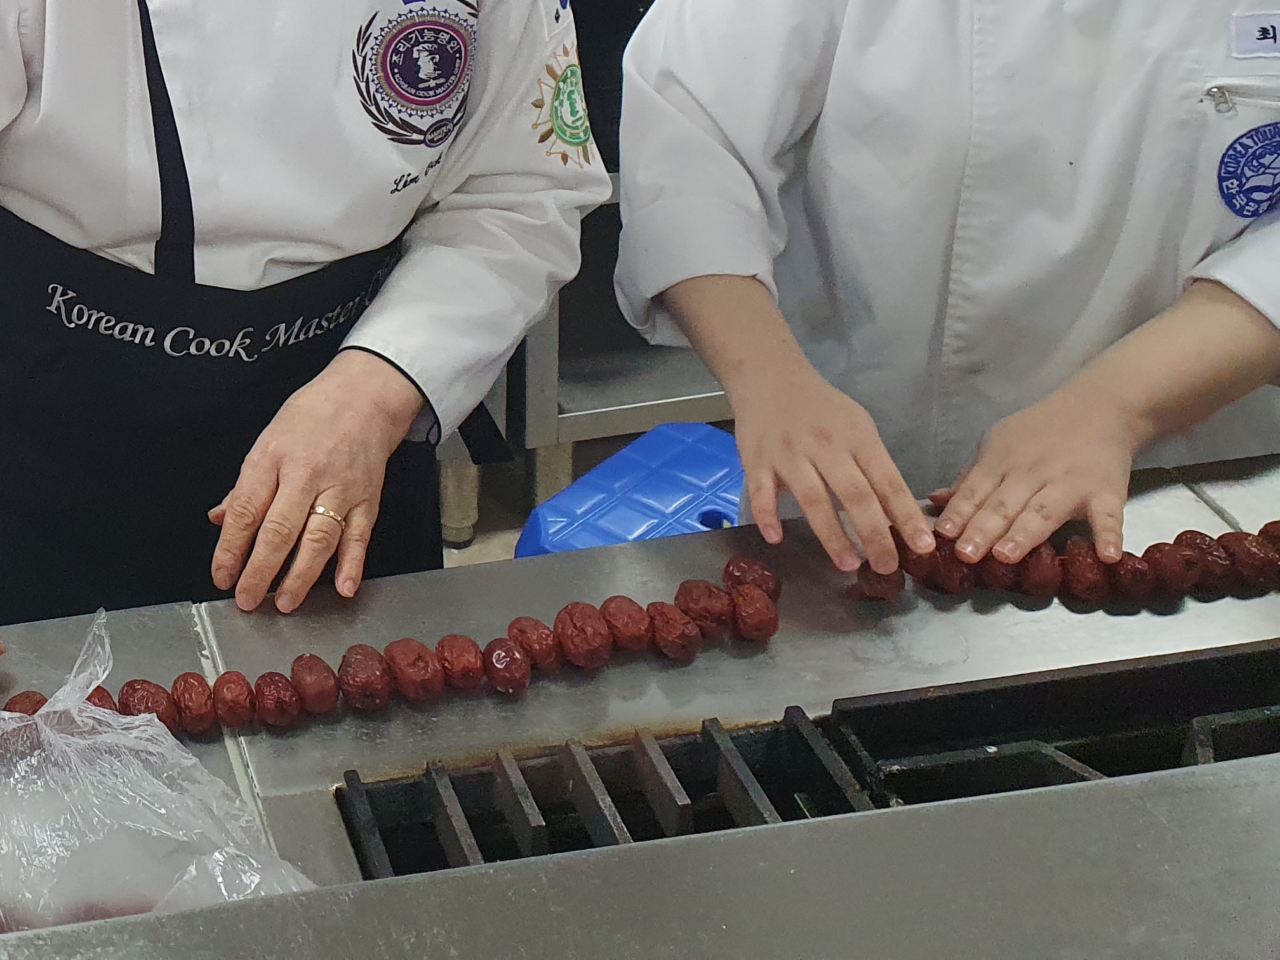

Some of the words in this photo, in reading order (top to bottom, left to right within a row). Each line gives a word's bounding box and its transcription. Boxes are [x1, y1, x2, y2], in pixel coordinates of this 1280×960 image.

[391, 29, 460, 66] 조리기능명인
[45, 283, 156, 348] Korean
[163, 325, 258, 362] Cook
[261, 291, 365, 353] Master
